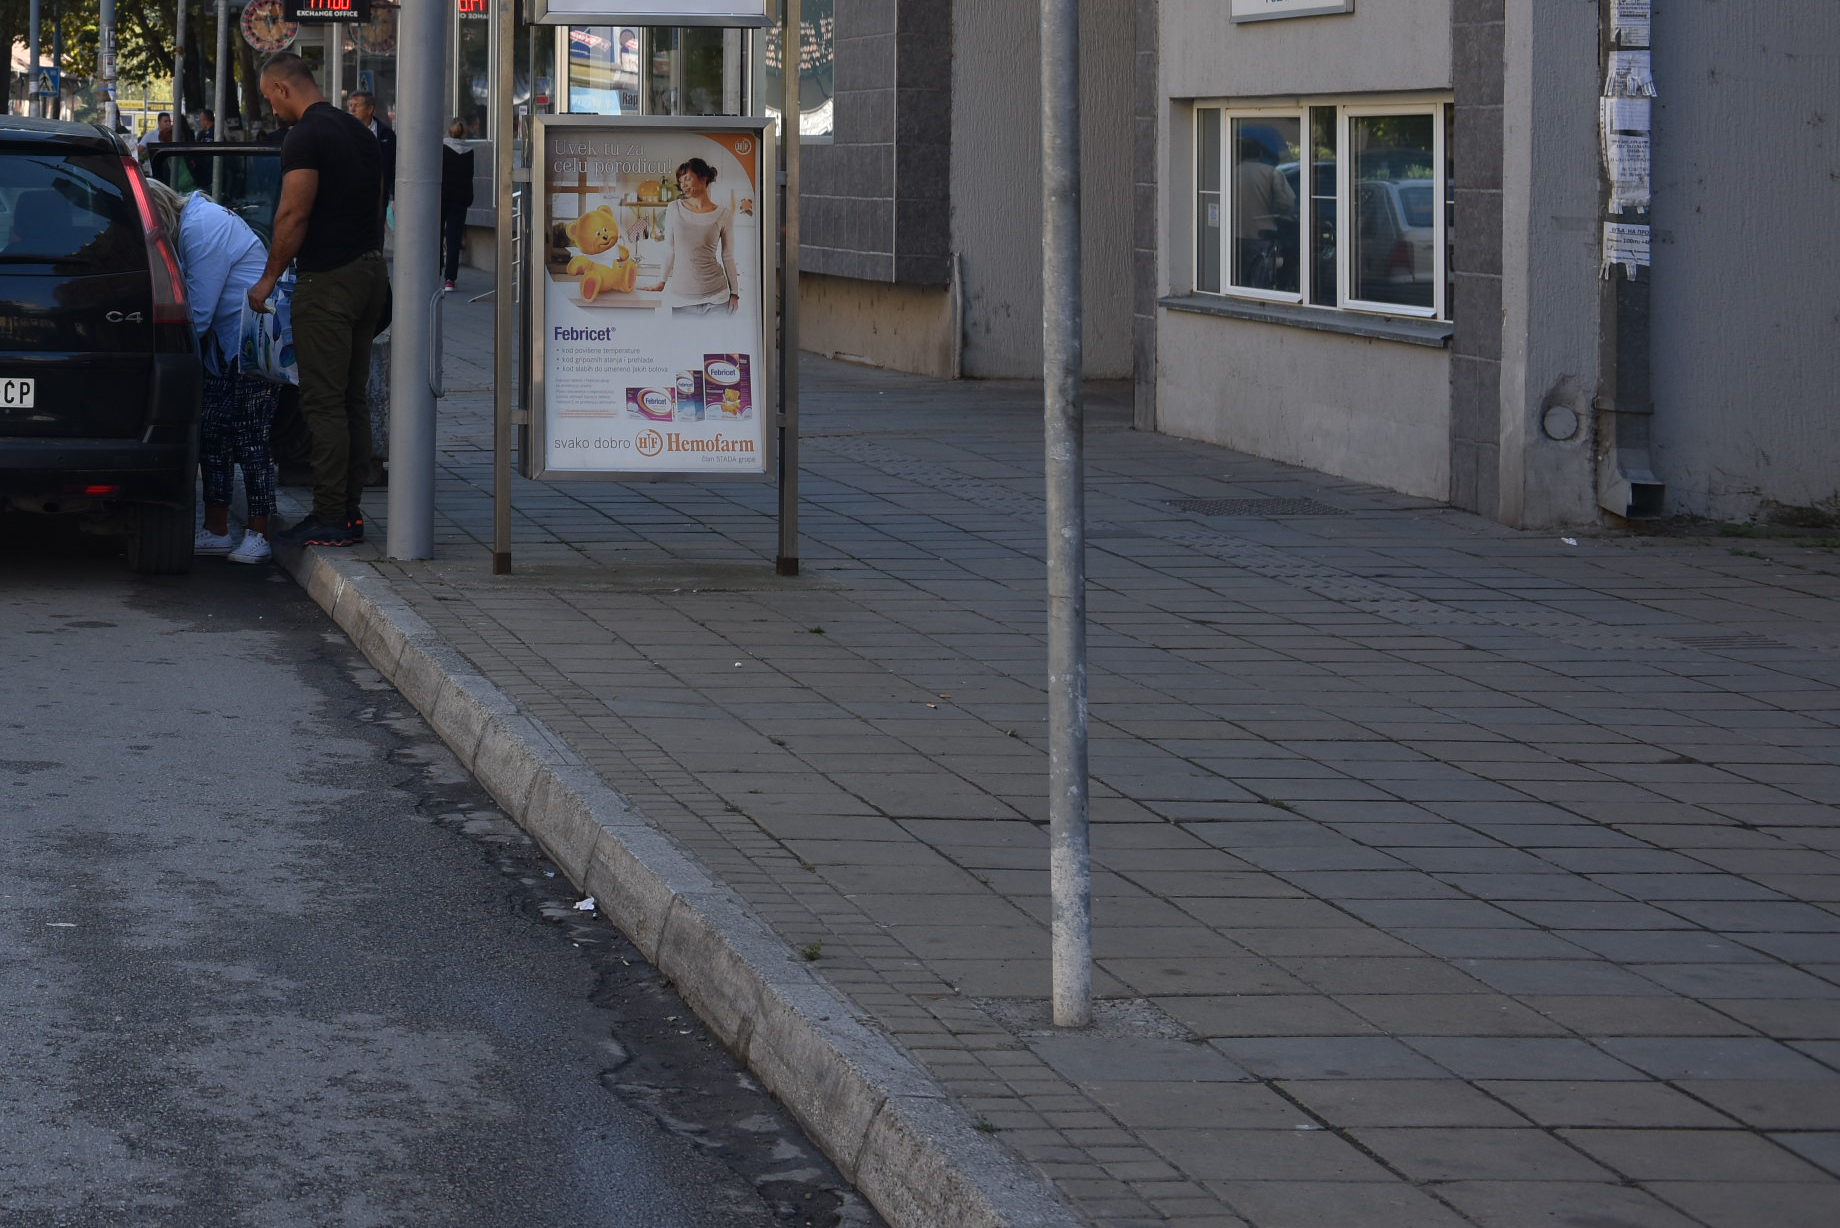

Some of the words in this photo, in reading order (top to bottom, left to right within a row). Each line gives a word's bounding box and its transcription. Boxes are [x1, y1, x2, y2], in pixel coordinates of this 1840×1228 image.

[555, 140, 597, 156] Uvek
[604, 143, 620, 156] tu
[626, 144, 645, 156] za
[554, 158, 587, 173] celu
[594, 158, 673, 177] porodicu!
[105, 310, 143, 323] C4
[554, 437, 590, 449] svako
[594, 436, 631, 449] dobro
[666, 432, 755, 453] Hemofarm
